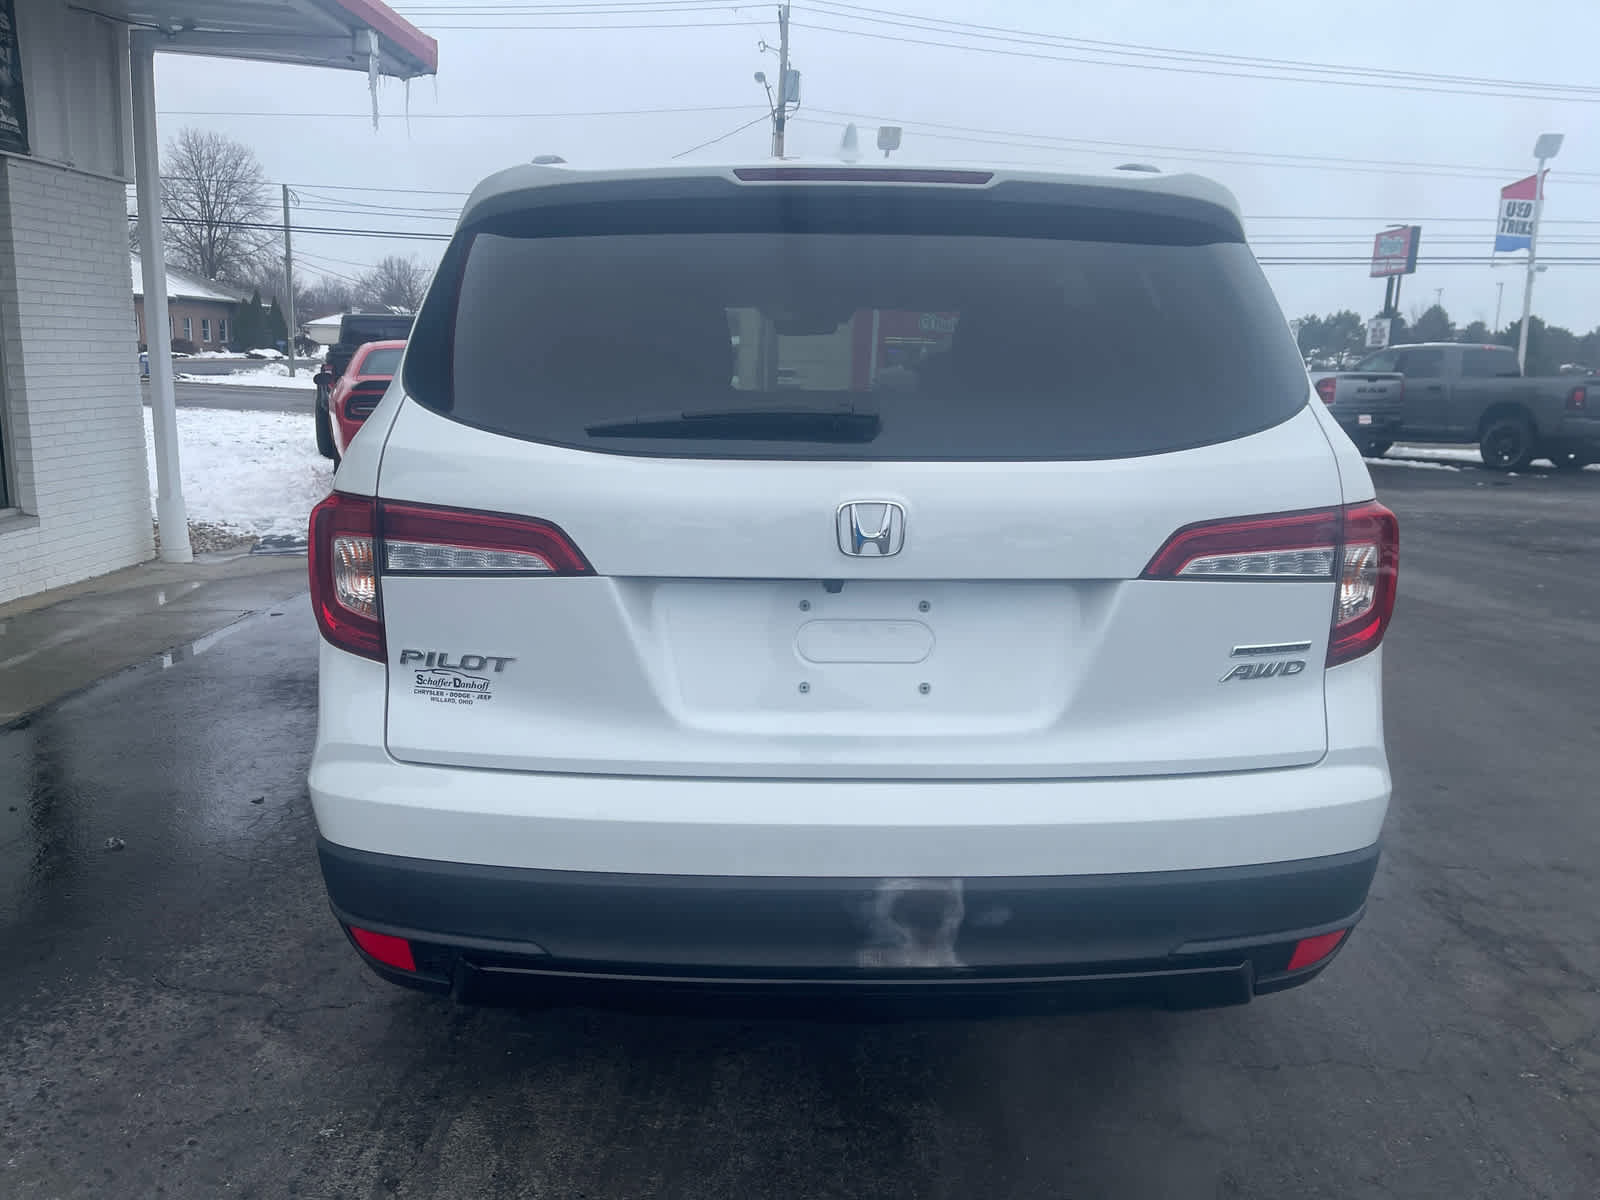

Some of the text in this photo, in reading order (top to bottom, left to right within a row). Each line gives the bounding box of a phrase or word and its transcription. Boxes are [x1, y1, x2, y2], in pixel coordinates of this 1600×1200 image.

[1506, 201, 1532, 218] USED
[400, 649, 518, 673] PILOT
[1219, 660, 1306, 682] AWD
[414, 688, 444, 697] CHRYSLER
[449, 691, 471, 699] DODGE
